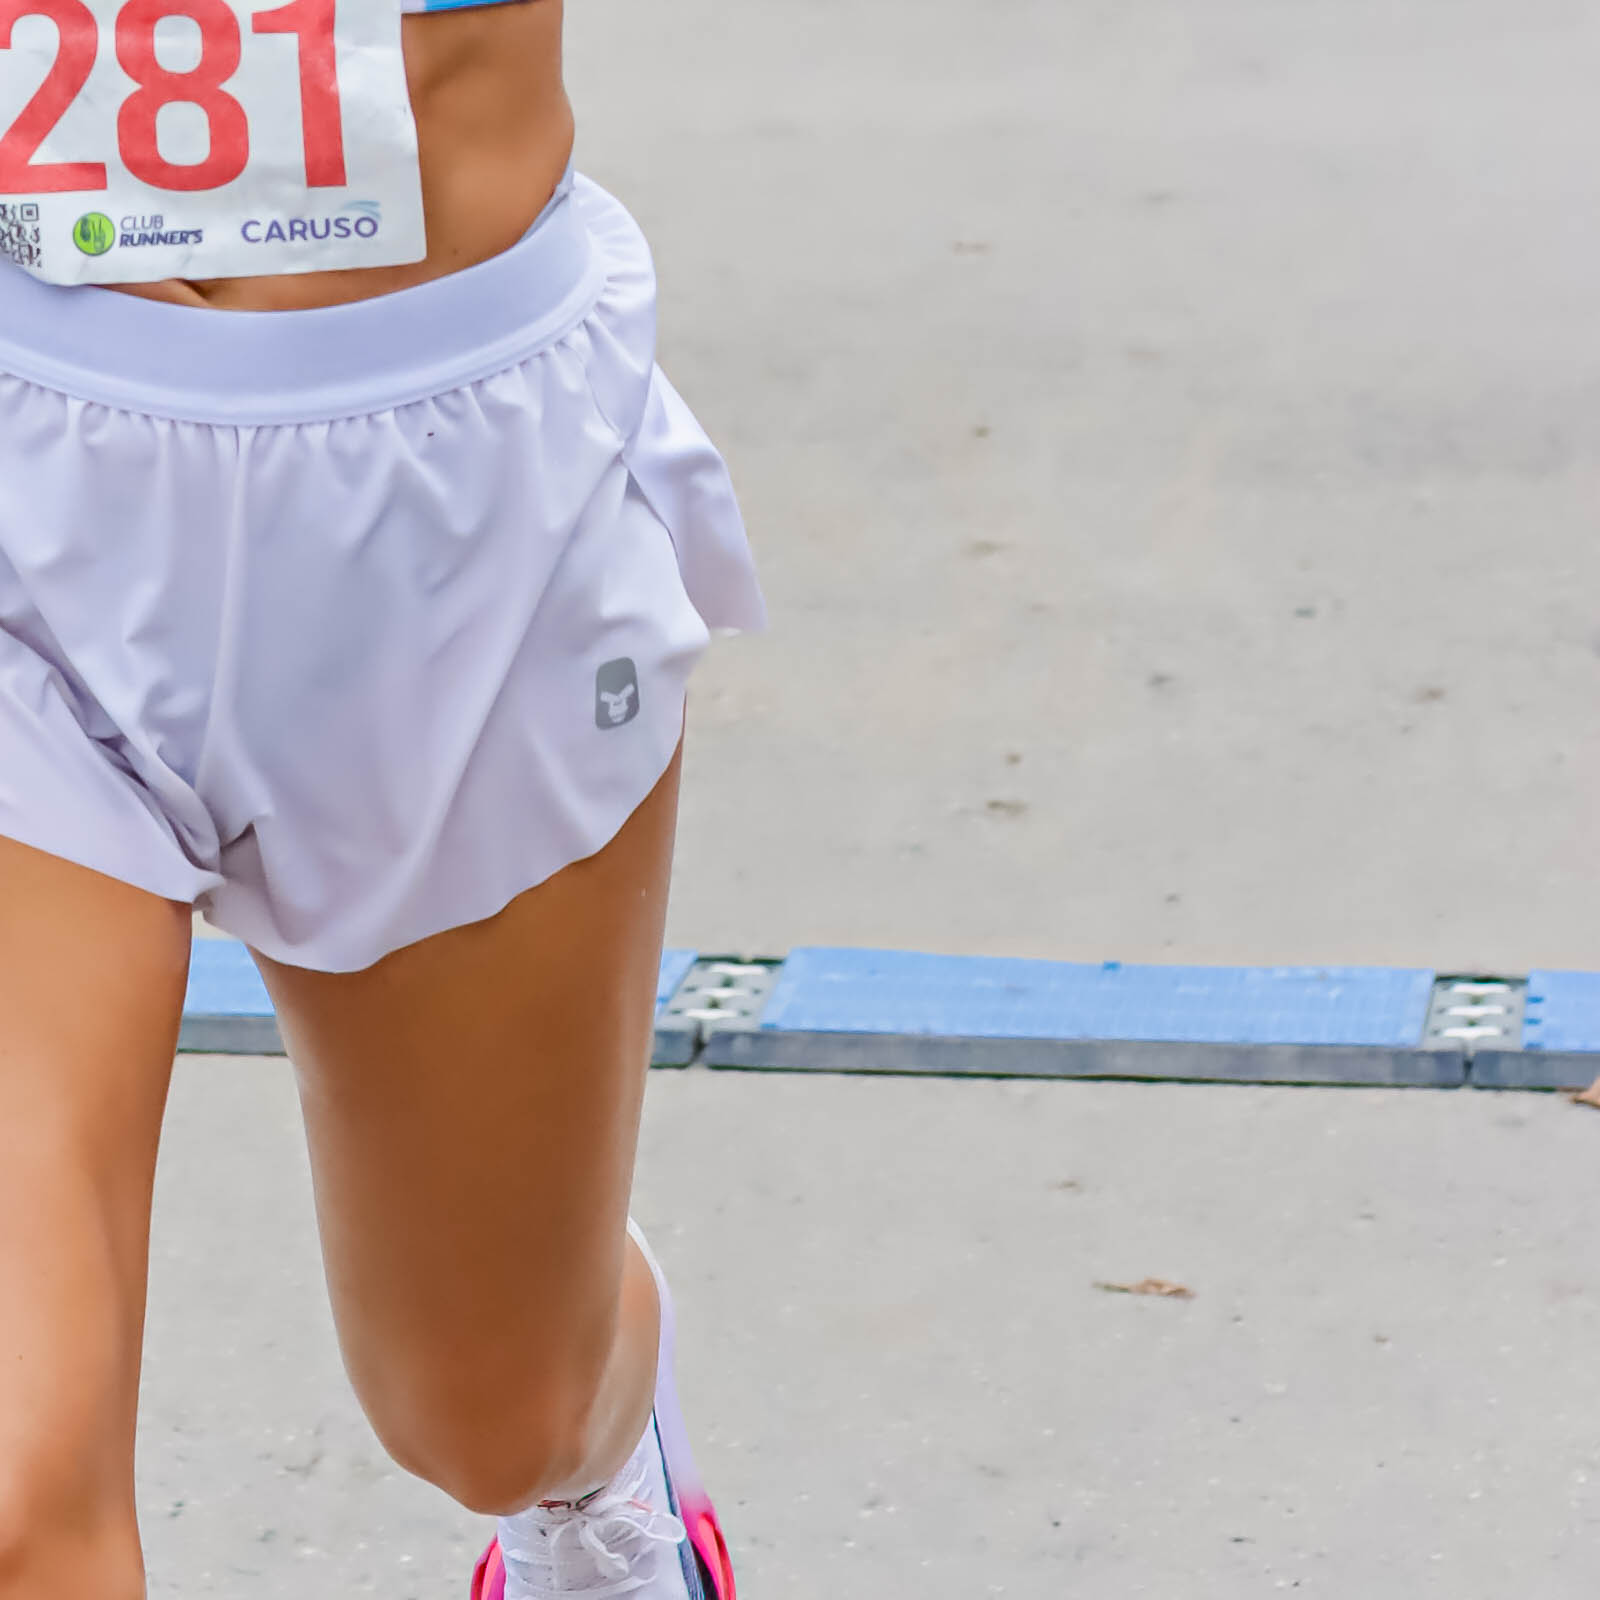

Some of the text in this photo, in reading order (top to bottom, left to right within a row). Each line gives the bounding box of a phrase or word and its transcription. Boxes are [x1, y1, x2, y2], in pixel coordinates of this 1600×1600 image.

[120, 215, 164, 231] CLUB
[241, 217, 379, 243] CARUSO
[119, 229, 203, 248] RUNNER'S
